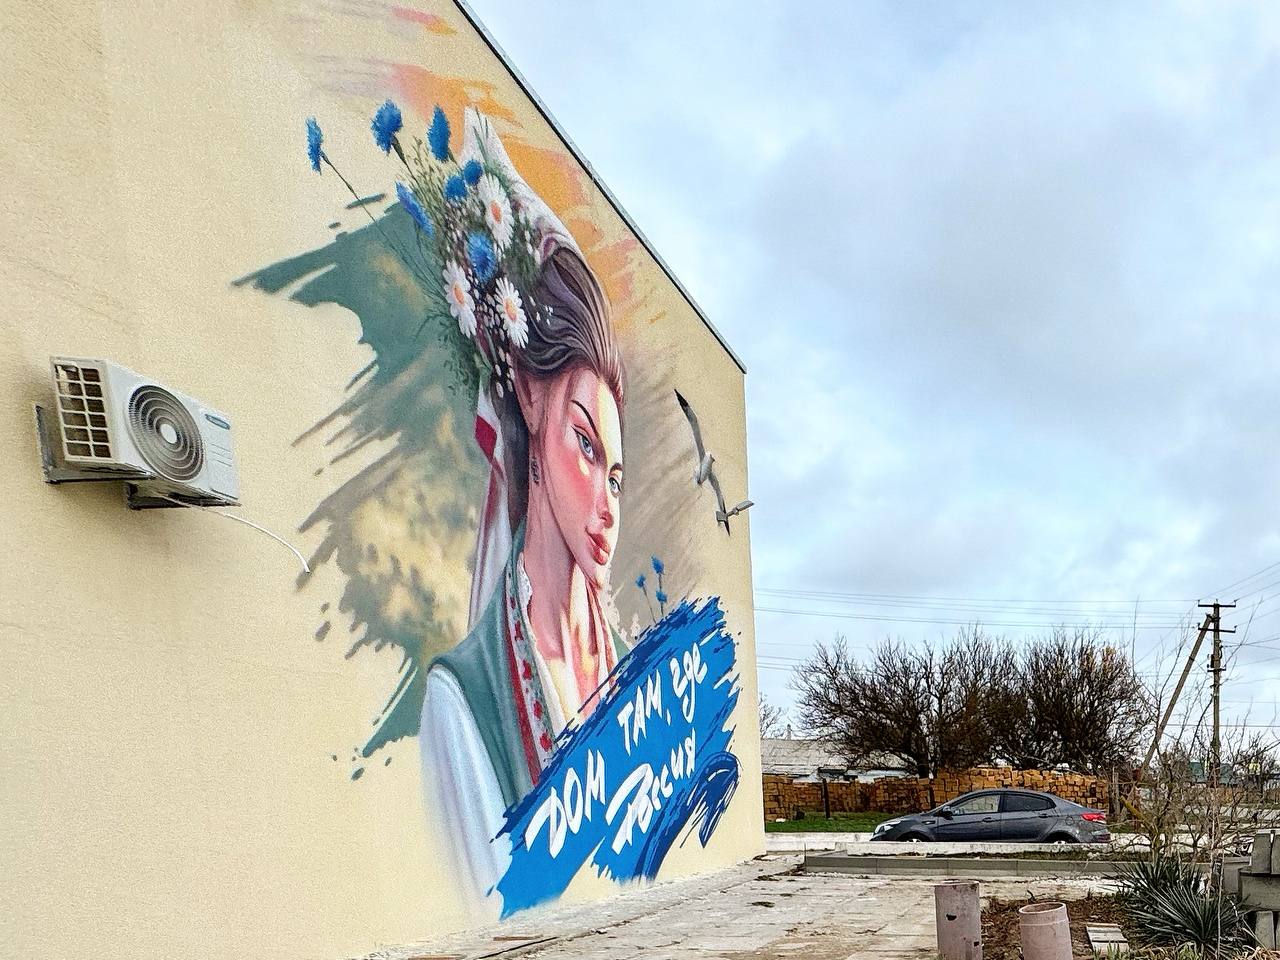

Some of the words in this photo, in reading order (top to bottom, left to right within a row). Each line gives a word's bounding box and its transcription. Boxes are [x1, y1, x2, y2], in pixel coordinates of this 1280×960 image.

[525, 748, 606, 859] ДОМ
[617, 670, 671, 756] ТАМ,
[669, 643, 707, 723] где
[605, 727, 696, 855] Россия
